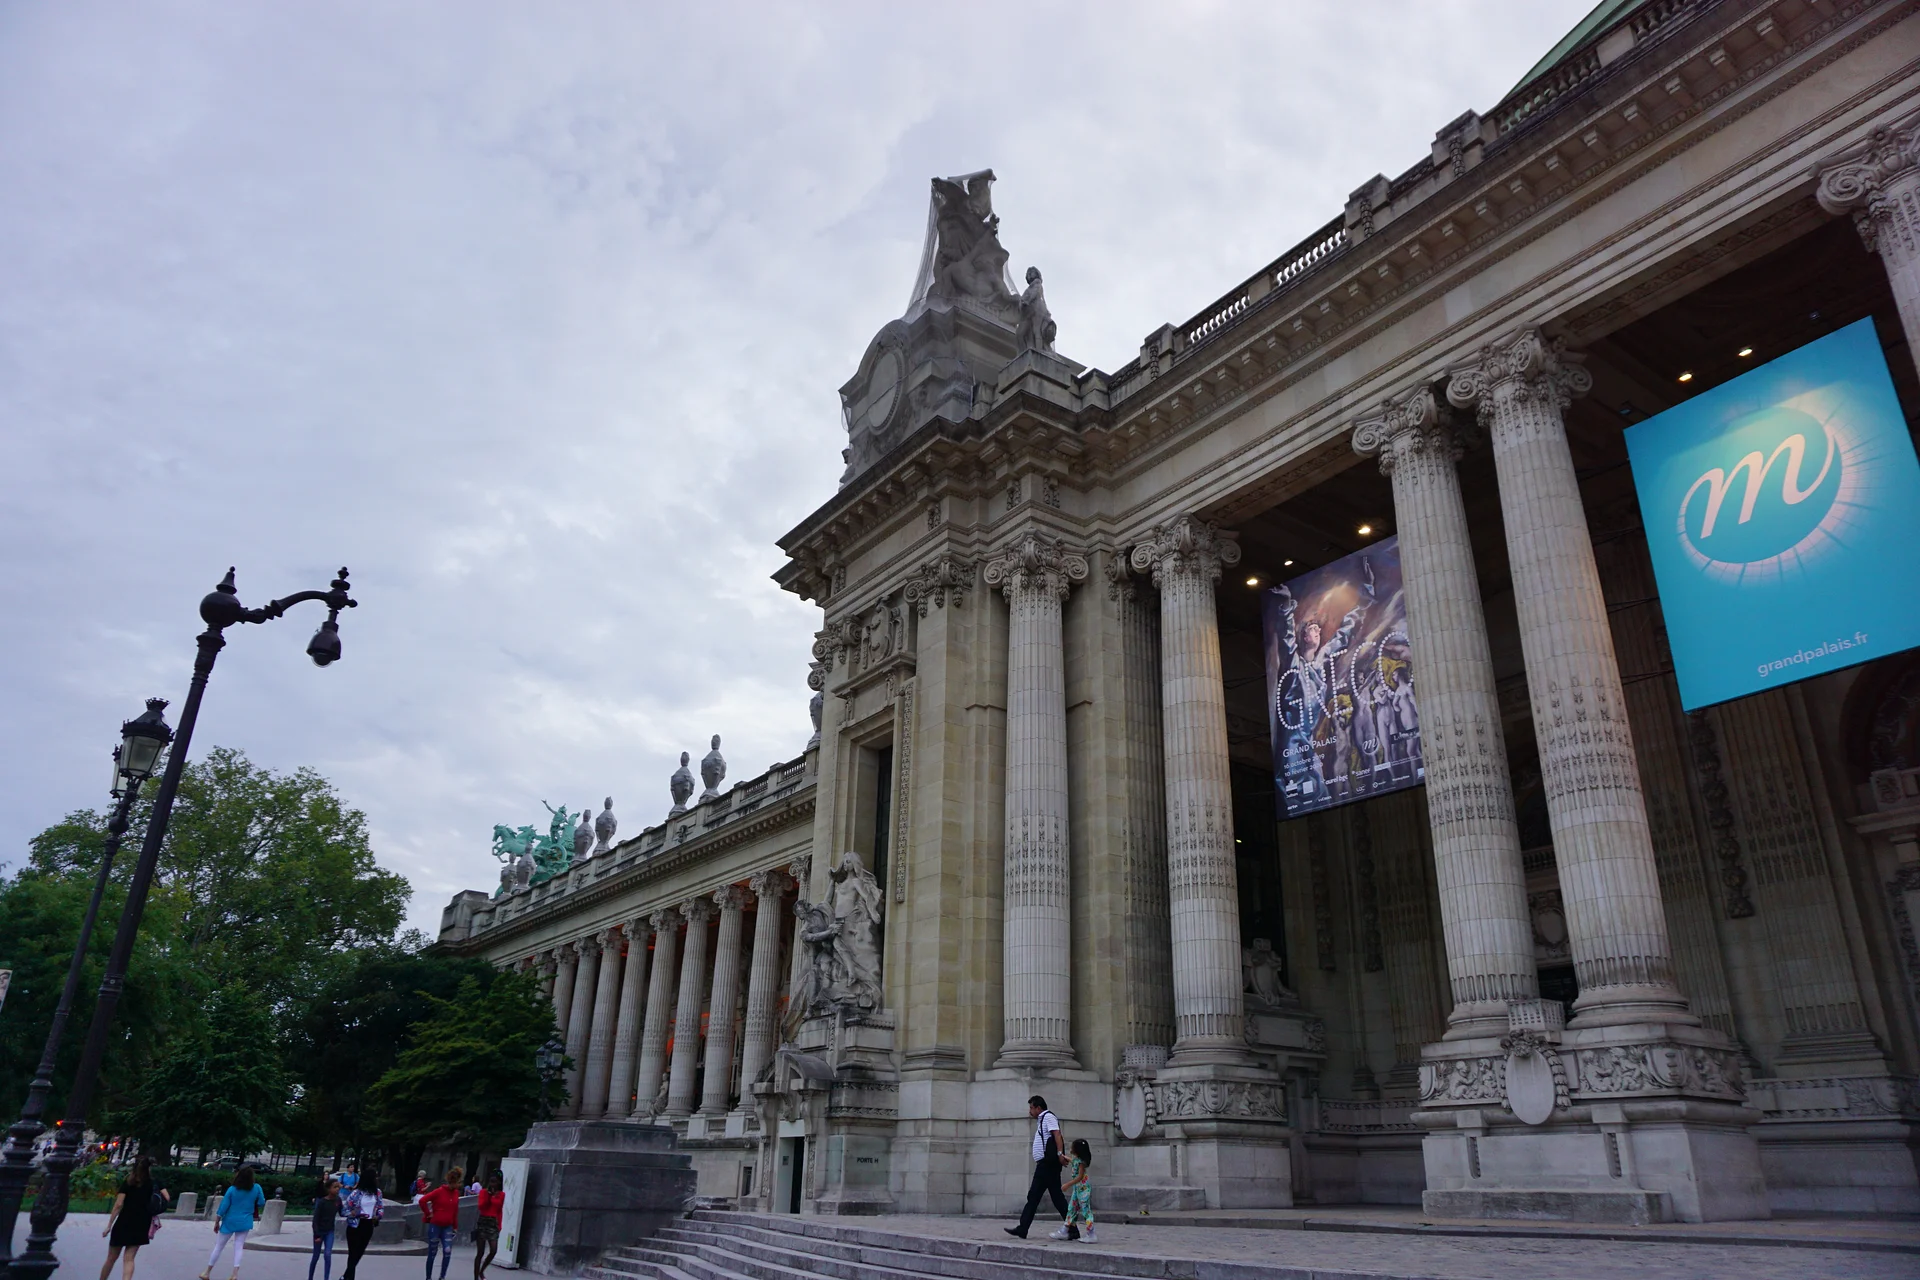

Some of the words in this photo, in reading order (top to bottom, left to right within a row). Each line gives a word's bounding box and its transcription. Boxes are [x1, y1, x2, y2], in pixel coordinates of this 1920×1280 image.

[1757, 631, 1868, 678] grandpalais.fr
[1276, 631, 1414, 730] GRECO
[1290, 757, 1311, 768] octobre
[1291, 766, 1308, 775] février
